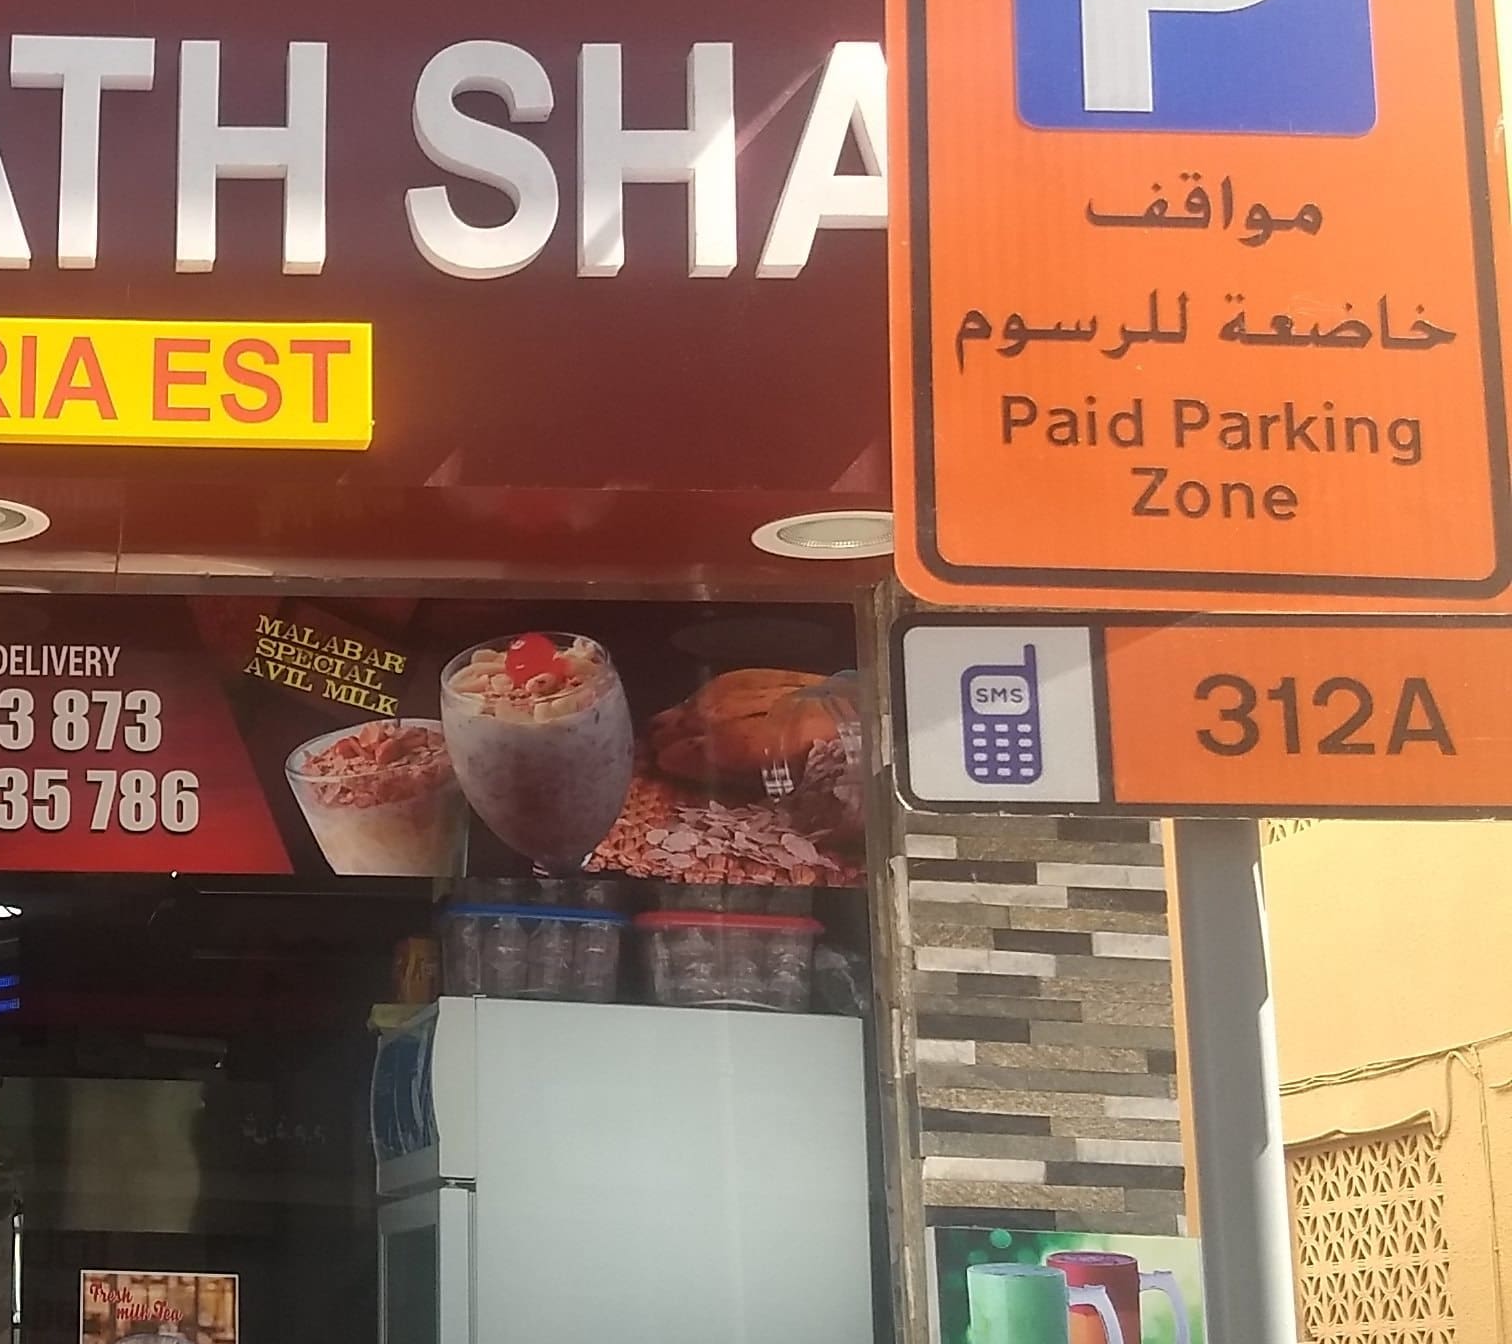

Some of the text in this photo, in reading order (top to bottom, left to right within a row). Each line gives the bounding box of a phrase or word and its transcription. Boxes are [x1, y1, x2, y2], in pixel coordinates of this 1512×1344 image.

[1086, 171, 1324, 248] مواقف
[954, 288, 1457, 376] خاضعة للرسوم
[151, 337, 352, 424] EST
[1001, 394, 1423, 466] Paid Parking
[1131, 466, 1299, 521] Zone
[255, 614, 407, 675] MALABAR
[255, 637, 383, 691] SPECIAL
[243, 657, 399, 717] AVIL MILK
[975, 687, 1024, 704] SMS
[1195, 674, 1458, 758] 312A
[51, 689, 162, 753] 873
[86, 769, 200, 833] 786
[89, 1278, 133, 1303] Fresh
